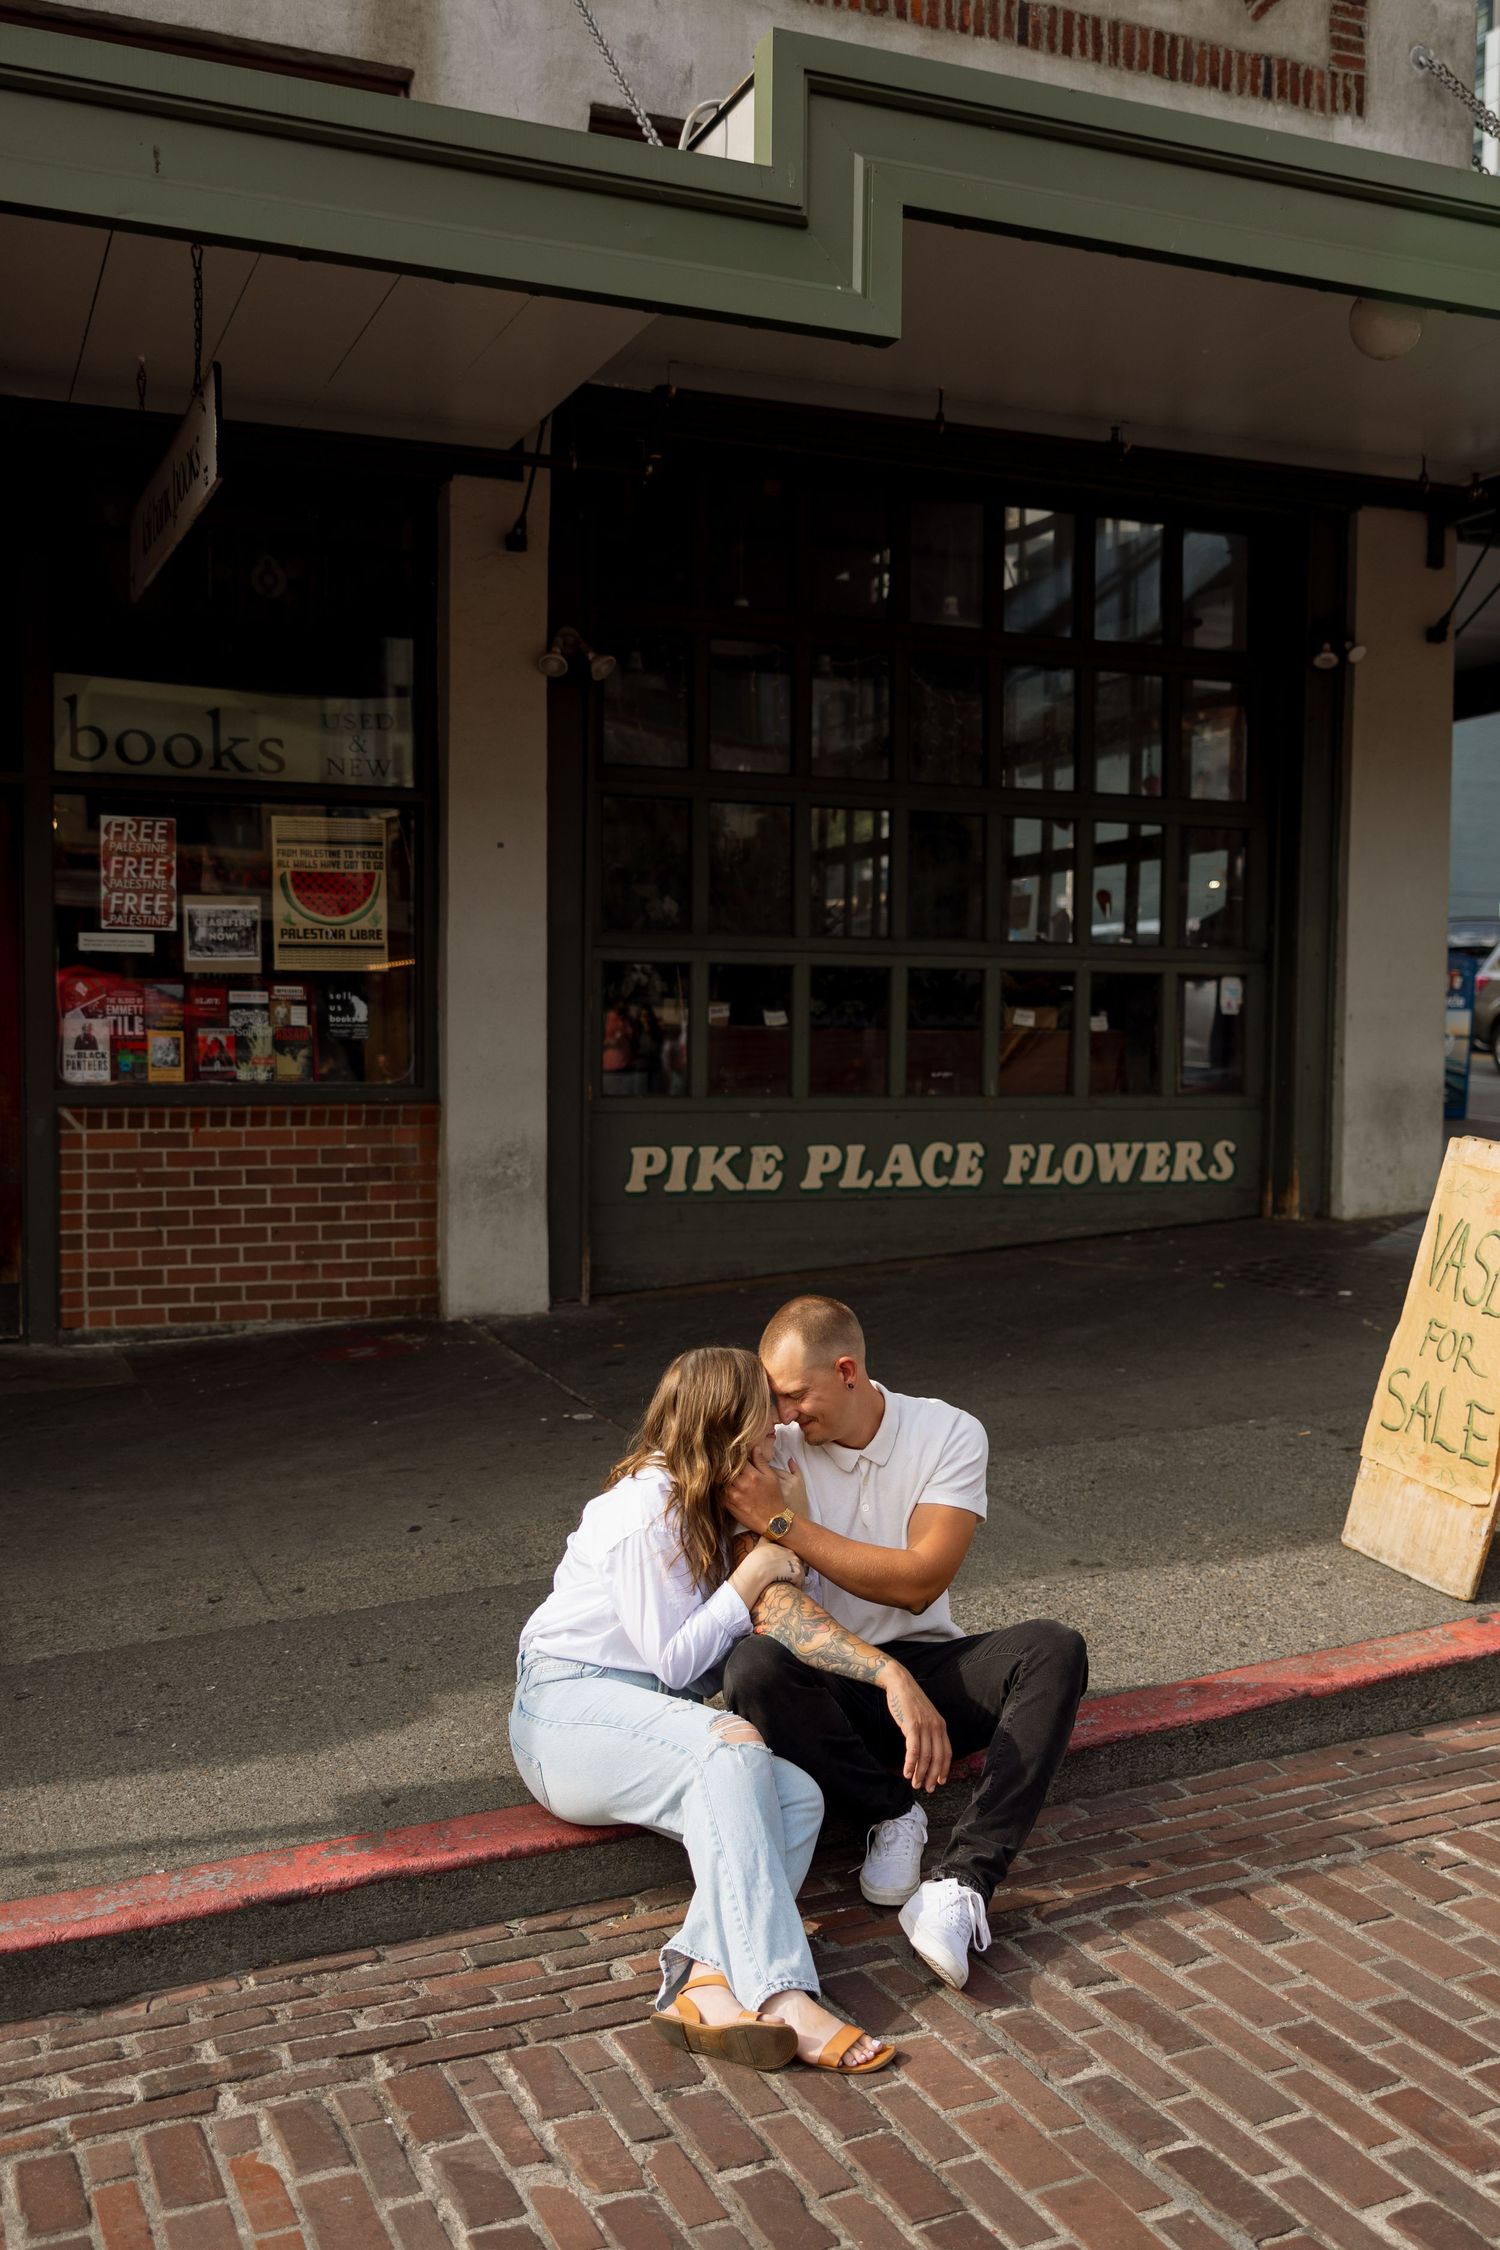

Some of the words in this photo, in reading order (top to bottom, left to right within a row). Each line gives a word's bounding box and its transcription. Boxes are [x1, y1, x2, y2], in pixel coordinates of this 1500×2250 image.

[322, 712, 394, 731] USED
[63, 694, 286, 774] books
[349, 736, 367, 754] &
[327, 758, 392, 778] NEW
[109, 820, 169, 843] FREE
[108, 842, 168, 854] PALESTINE
[109, 856, 169, 880] FREE
[109, 879, 168, 891] PALESTINE
[109, 891, 169, 915] FREE
[109, 914, 169, 926] PALESTINE
[194, 918, 253, 928] CEASEFIRE
[208, 931, 239, 941] NOW!
[350, 929, 383, 941] LIBRE
[105, 1004, 144, 1015] EMMETT
[77, 1051, 108, 1059] BLACK
[65, 1059, 109, 1072] PANTHERS
[624, 1143, 786, 1194] PIKE
[800, 1140, 988, 1192] PLACE
[1002, 1138, 1238, 1187] FLOWERS
[1419, 1317, 1489, 1379] FOR
[1380, 1366, 1496, 1468] SALE
